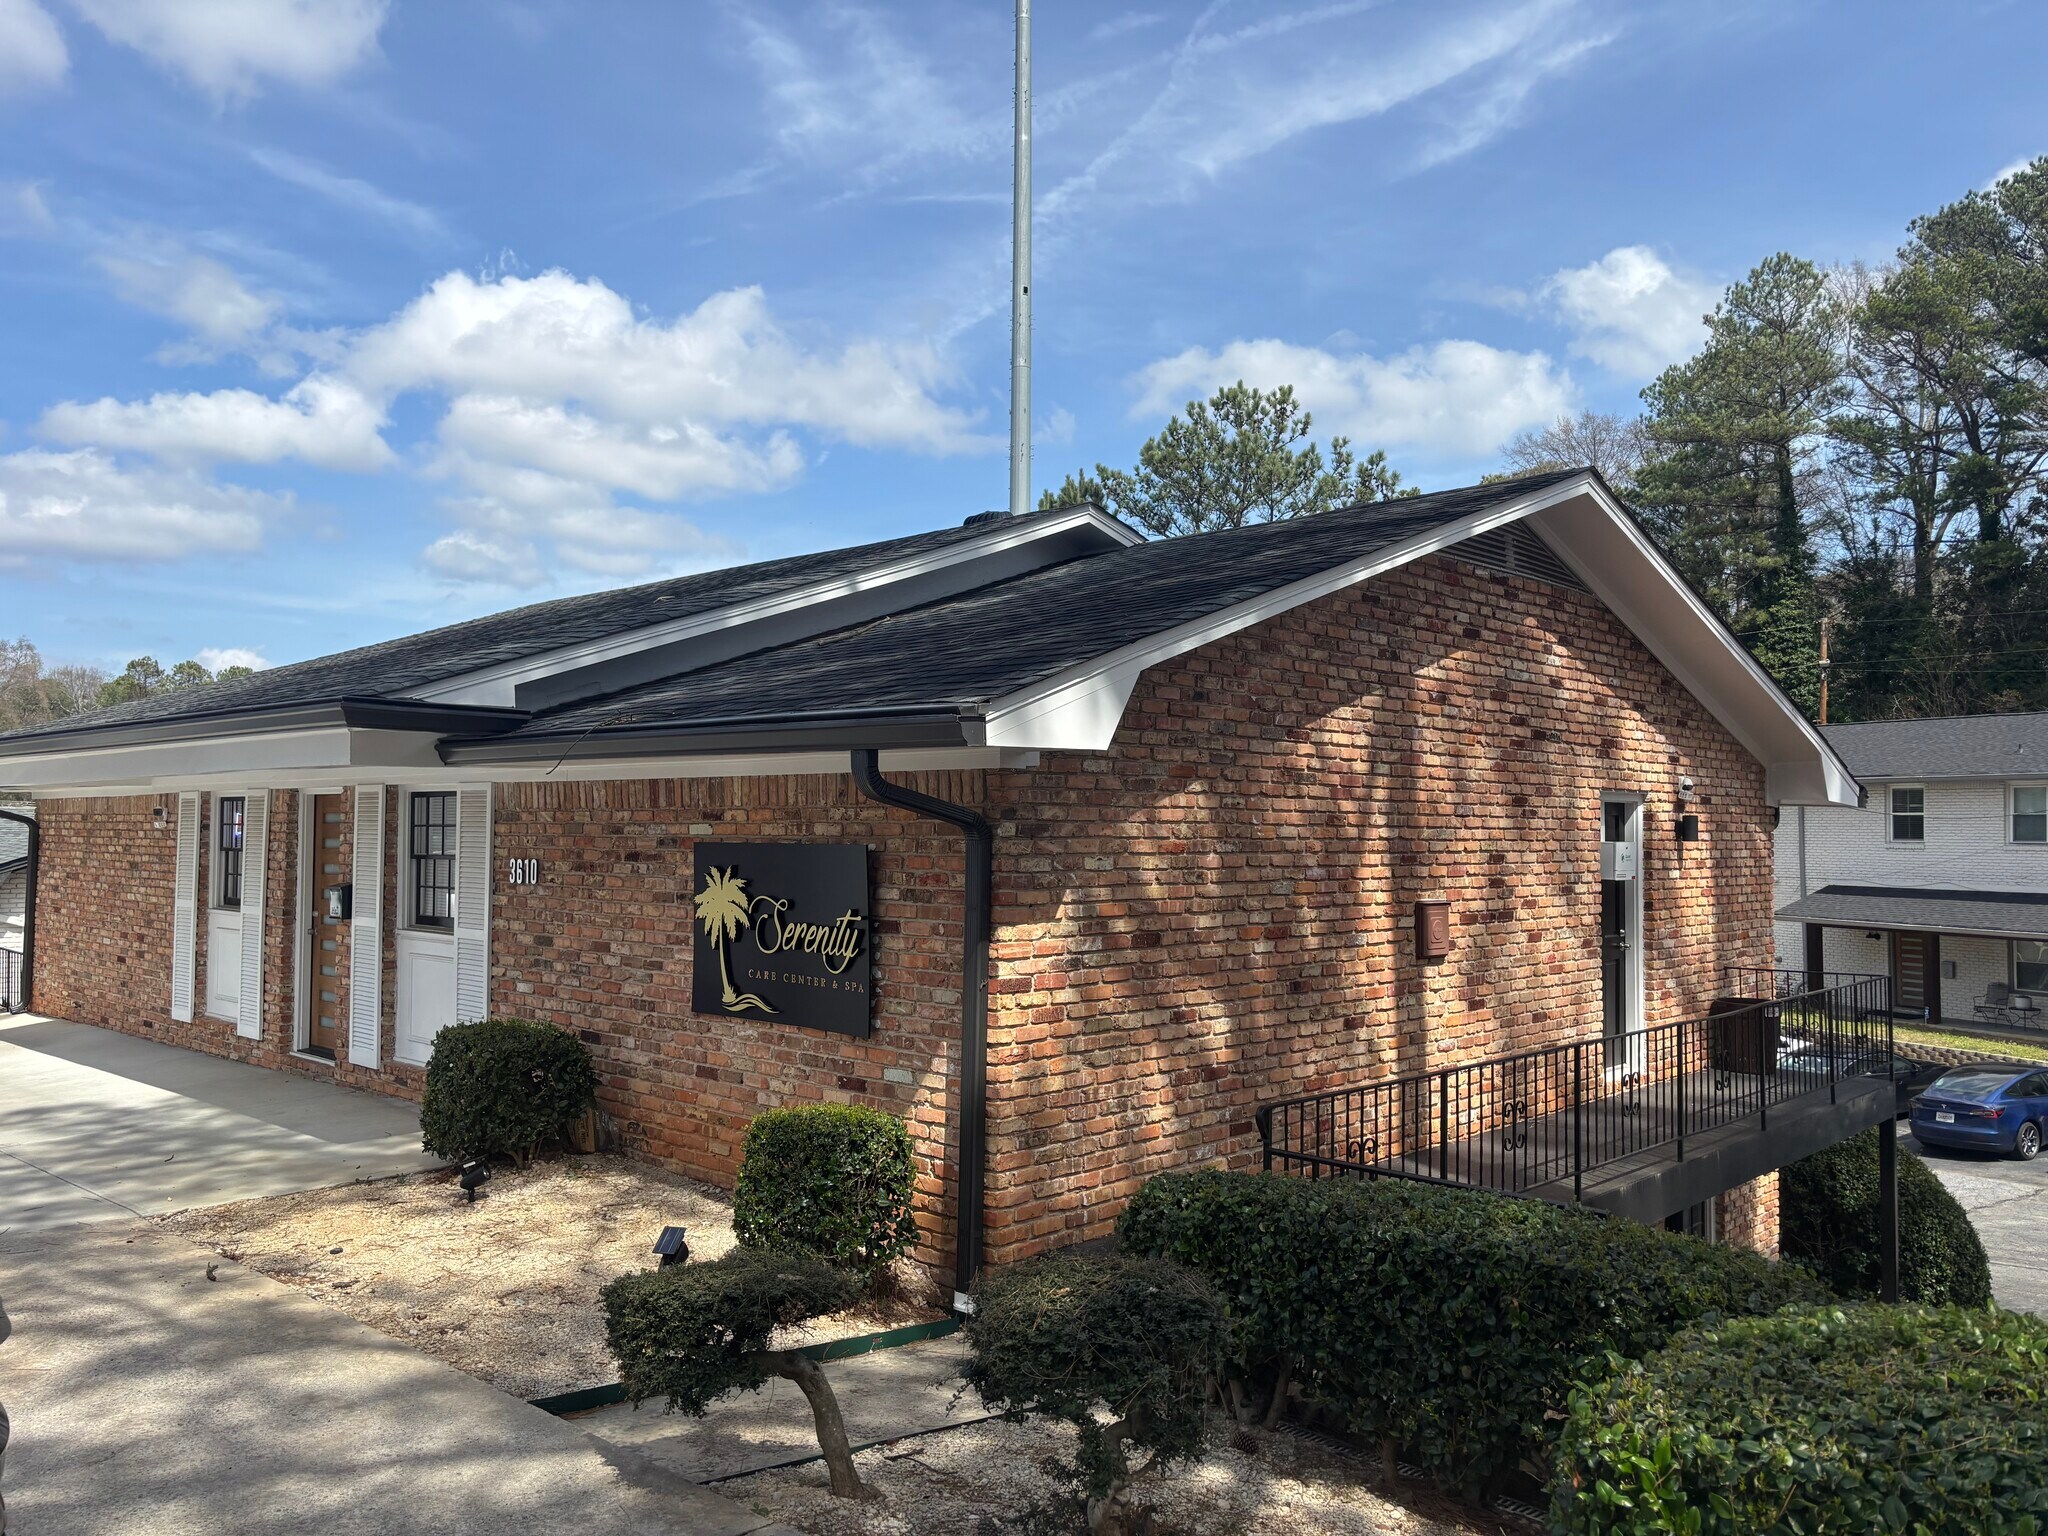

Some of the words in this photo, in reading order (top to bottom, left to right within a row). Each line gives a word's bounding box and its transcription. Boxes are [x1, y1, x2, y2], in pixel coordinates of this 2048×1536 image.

[509, 858, 537, 885] 3610
[748, 895, 862, 974] Serenity
[748, 968, 777, 981] CARE
[783, 973, 826, 988] CENTER
[832, 980, 839, 989] &
[844, 981, 865, 993] SPA
